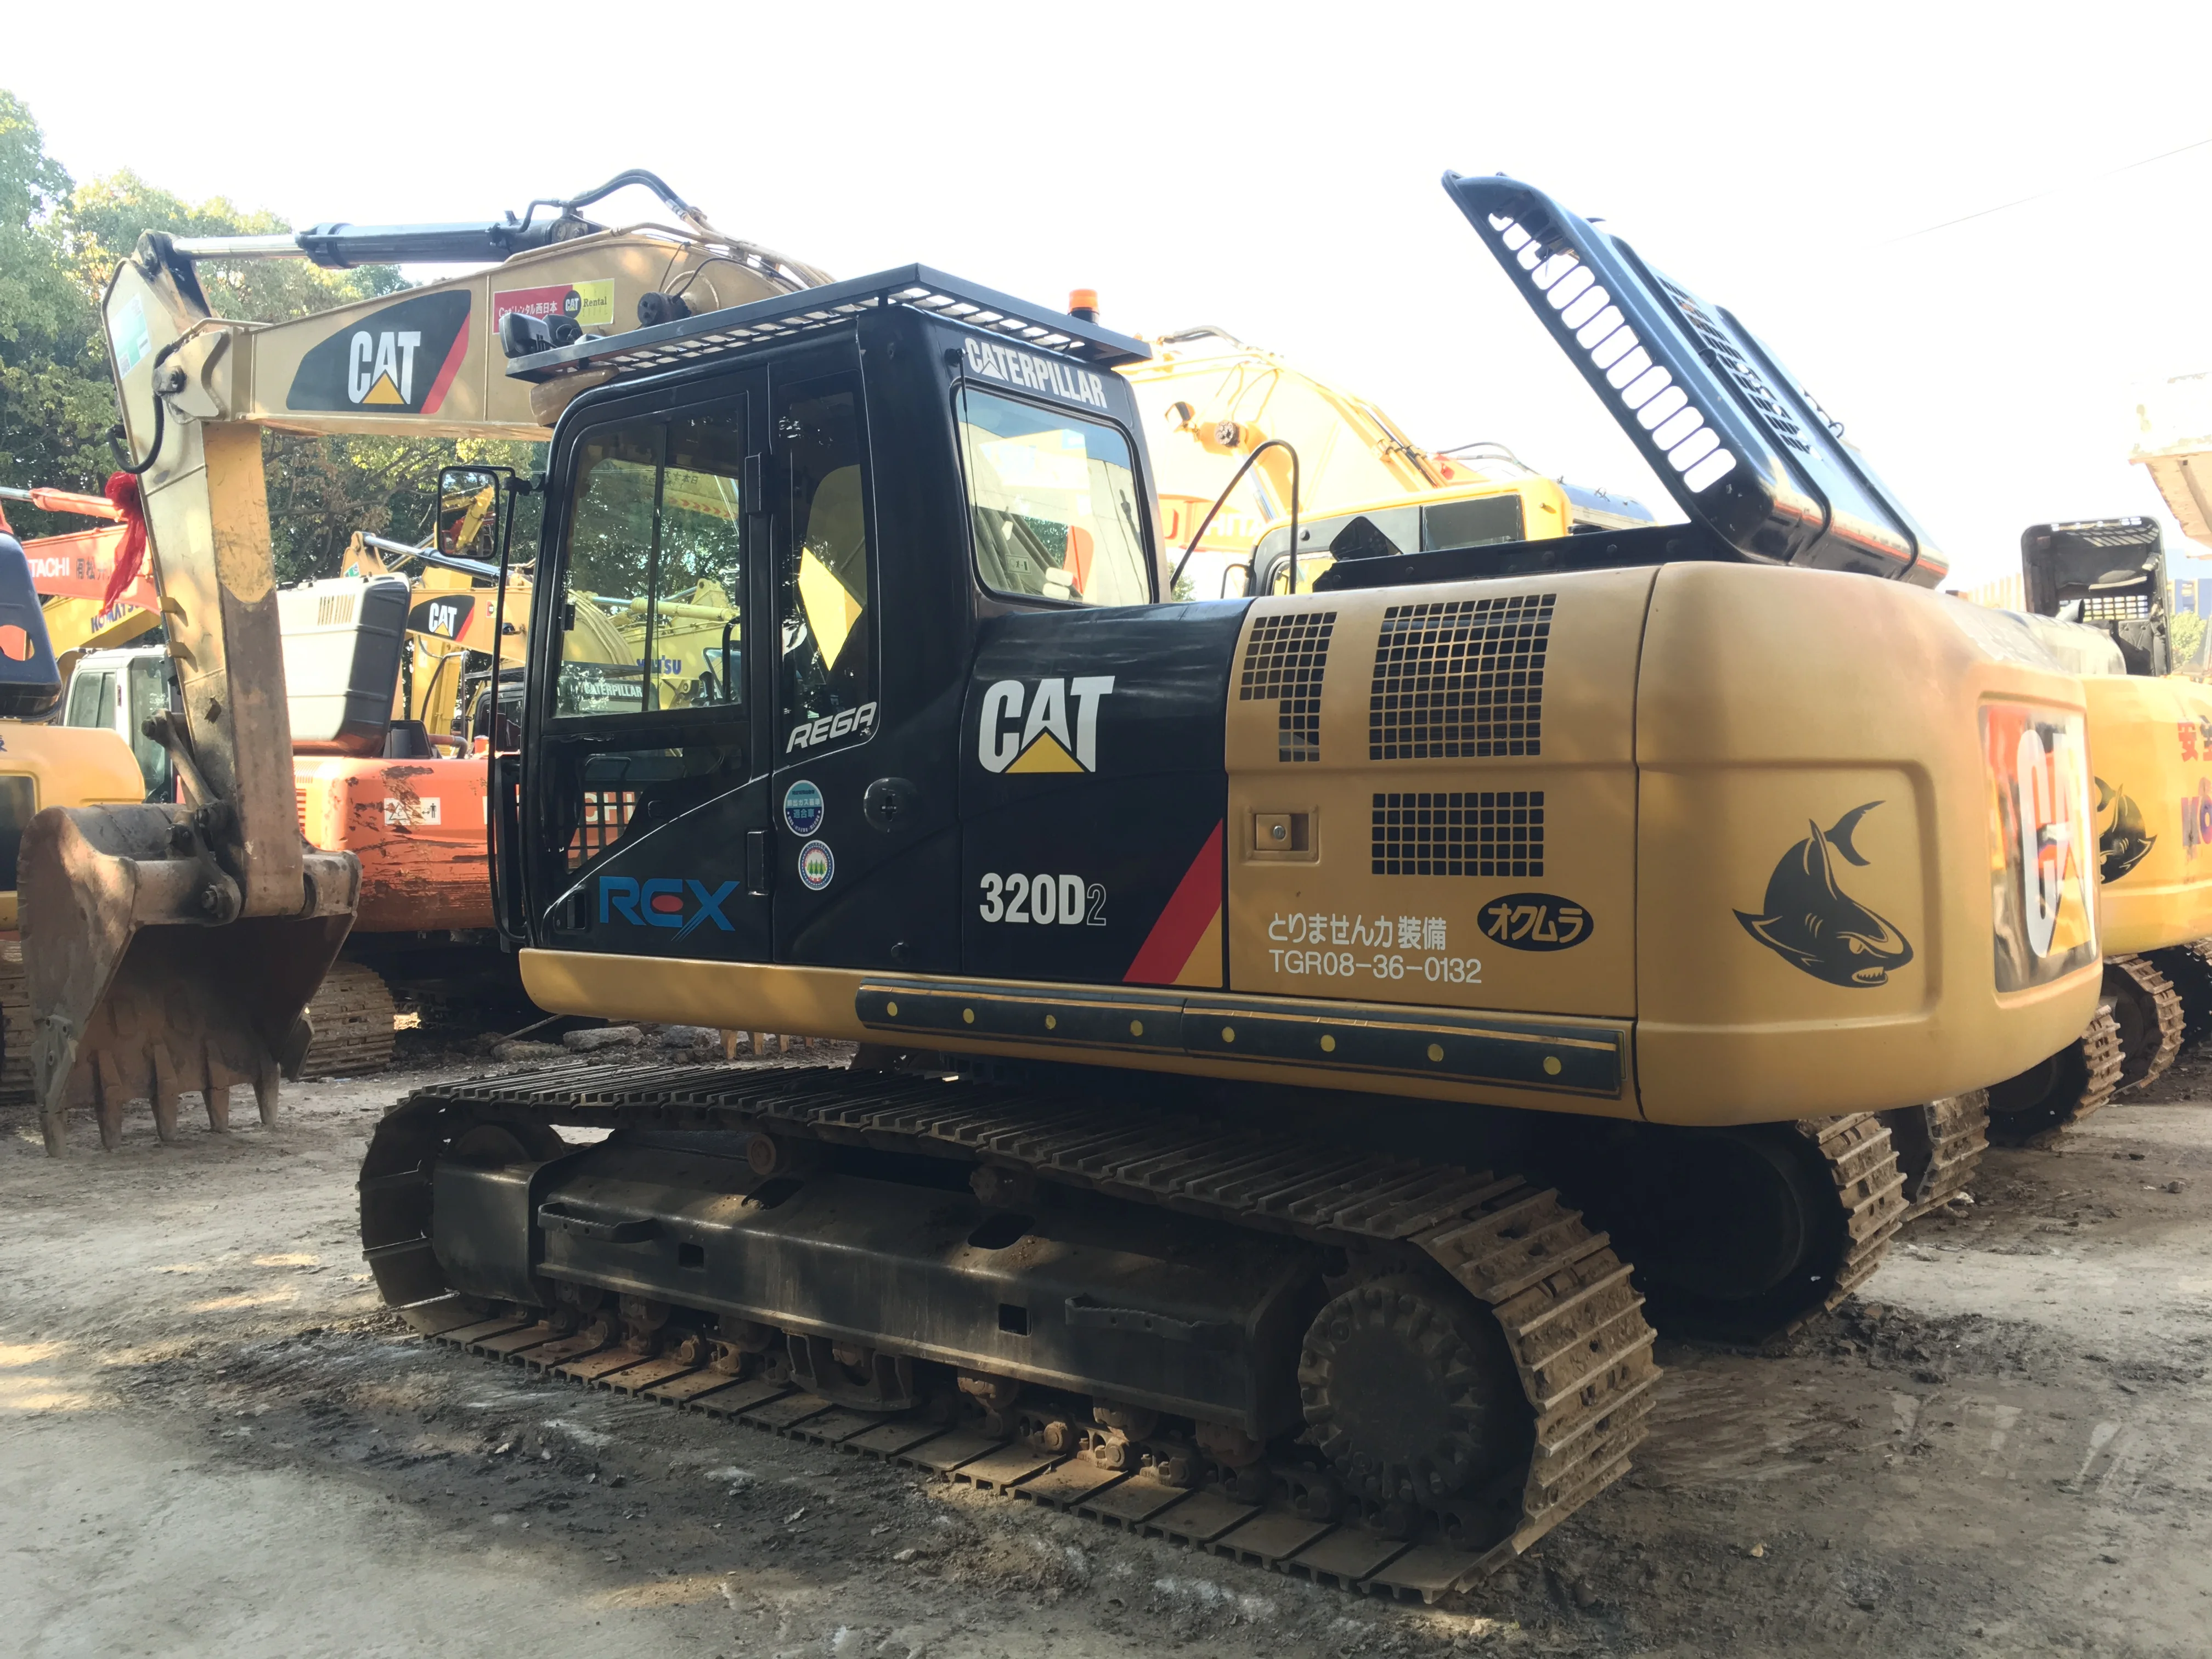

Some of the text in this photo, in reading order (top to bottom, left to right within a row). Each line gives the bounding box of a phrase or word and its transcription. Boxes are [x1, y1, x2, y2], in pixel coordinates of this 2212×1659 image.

[565, 297, 579, 311] CAT
[583, 296, 607, 307] Rental
[348, 331, 421, 404] CAT
[965, 337, 1107, 408] CATERPILLAR
[428, 602, 457, 637] CAT
[584, 682, 643, 697] CATERPILLAR
[786, 702, 877, 753] REGA
[979, 676, 1115, 773] CAT
[980, 873, 1106, 926] 320D2
[1488, 903, 1583, 943] オクムラ
[1268, 949, 1482, 983] TGR08-36-0132
